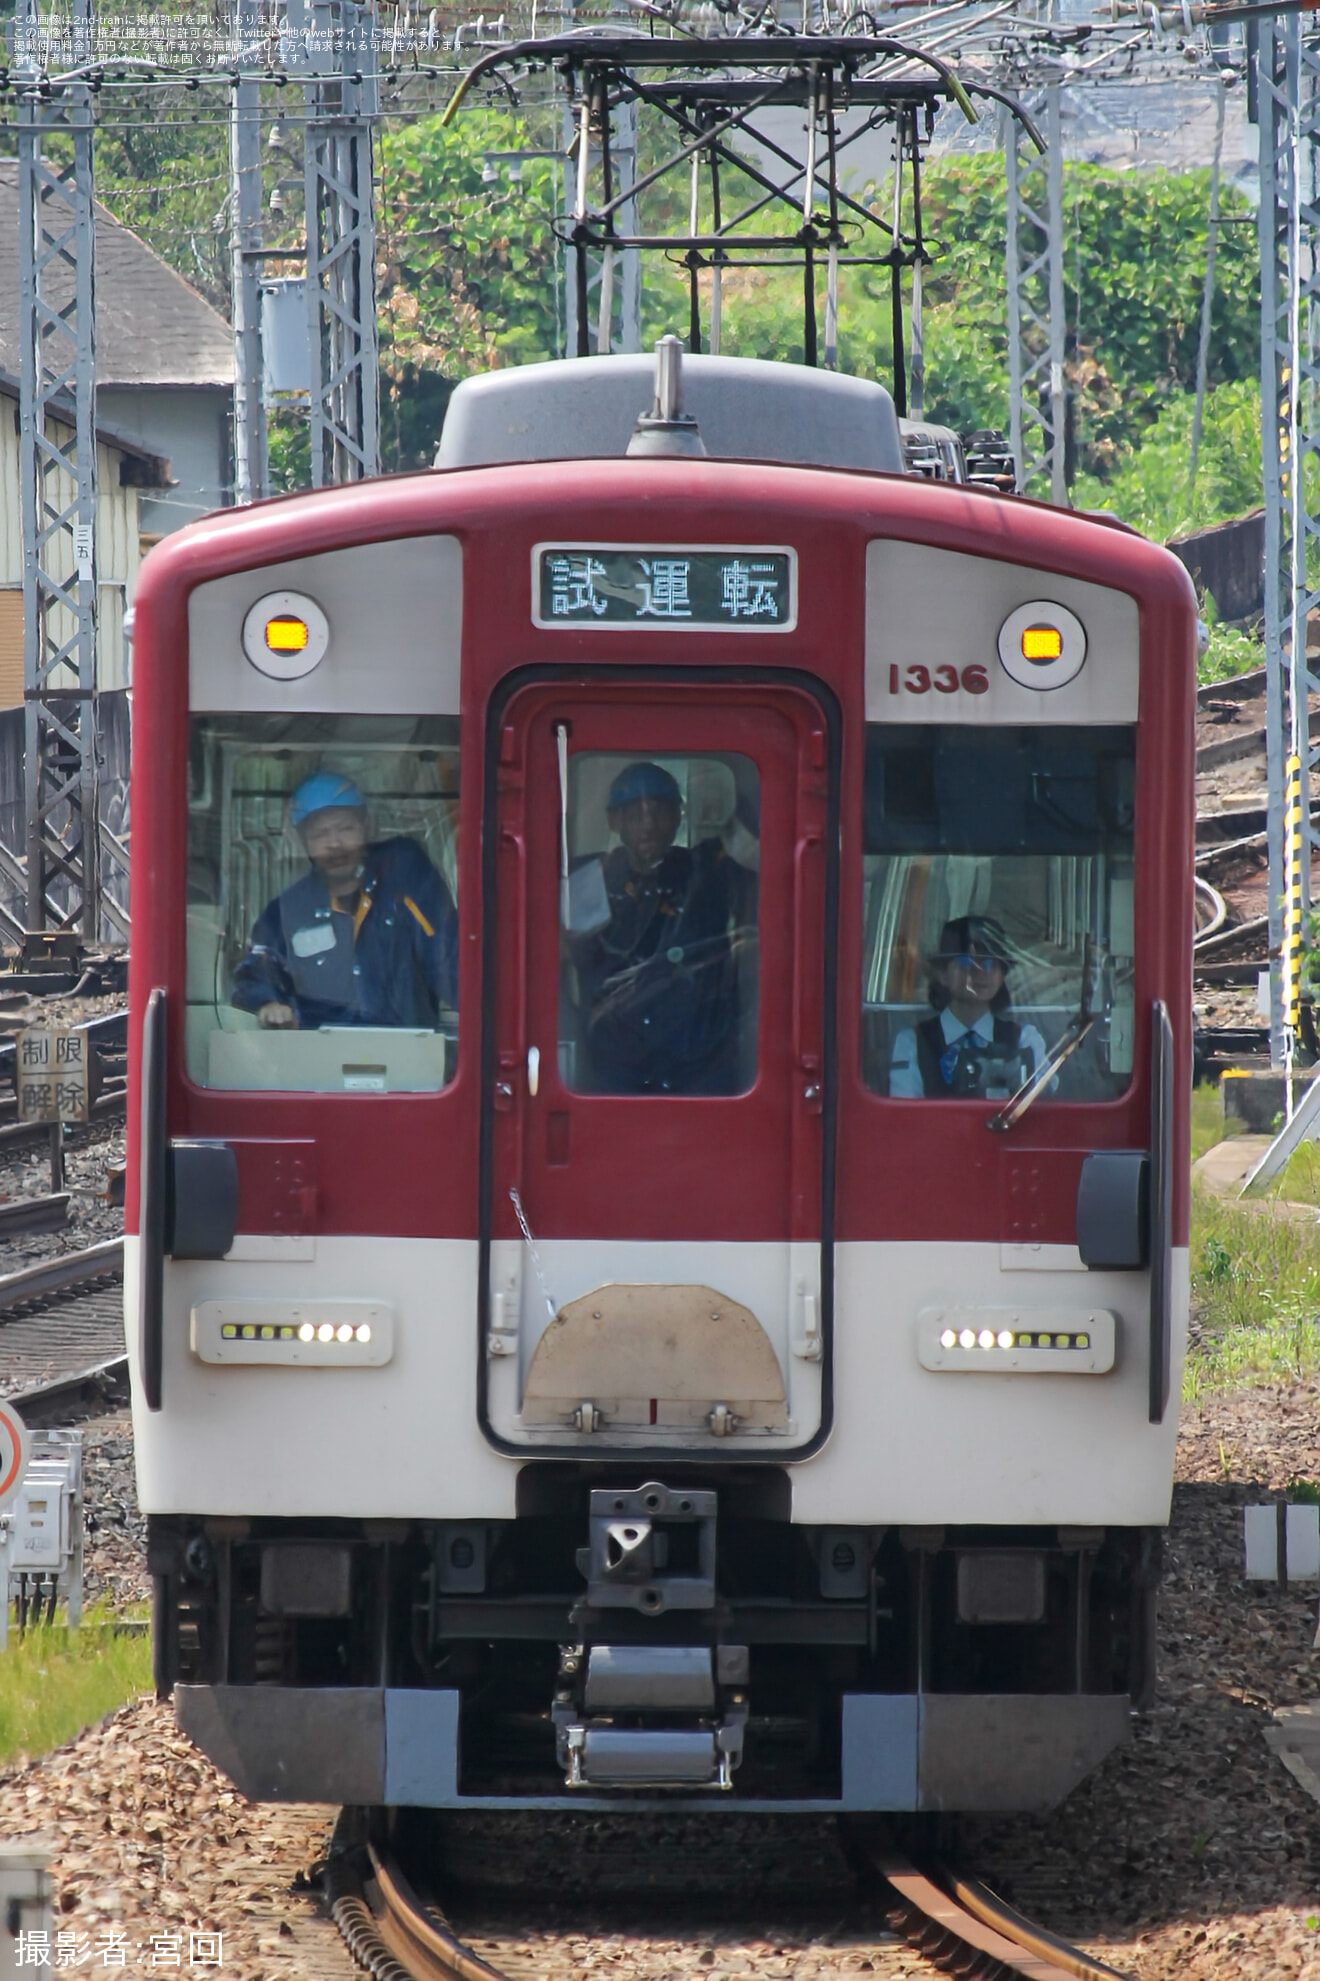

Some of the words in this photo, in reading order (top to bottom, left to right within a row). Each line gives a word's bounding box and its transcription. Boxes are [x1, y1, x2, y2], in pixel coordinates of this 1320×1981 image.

[550, 556, 779, 618] 試運転
[889, 663, 990, 695] 1336
[21, 1037, 83, 1065] 制限
[21, 1081, 85, 1115] 解除
